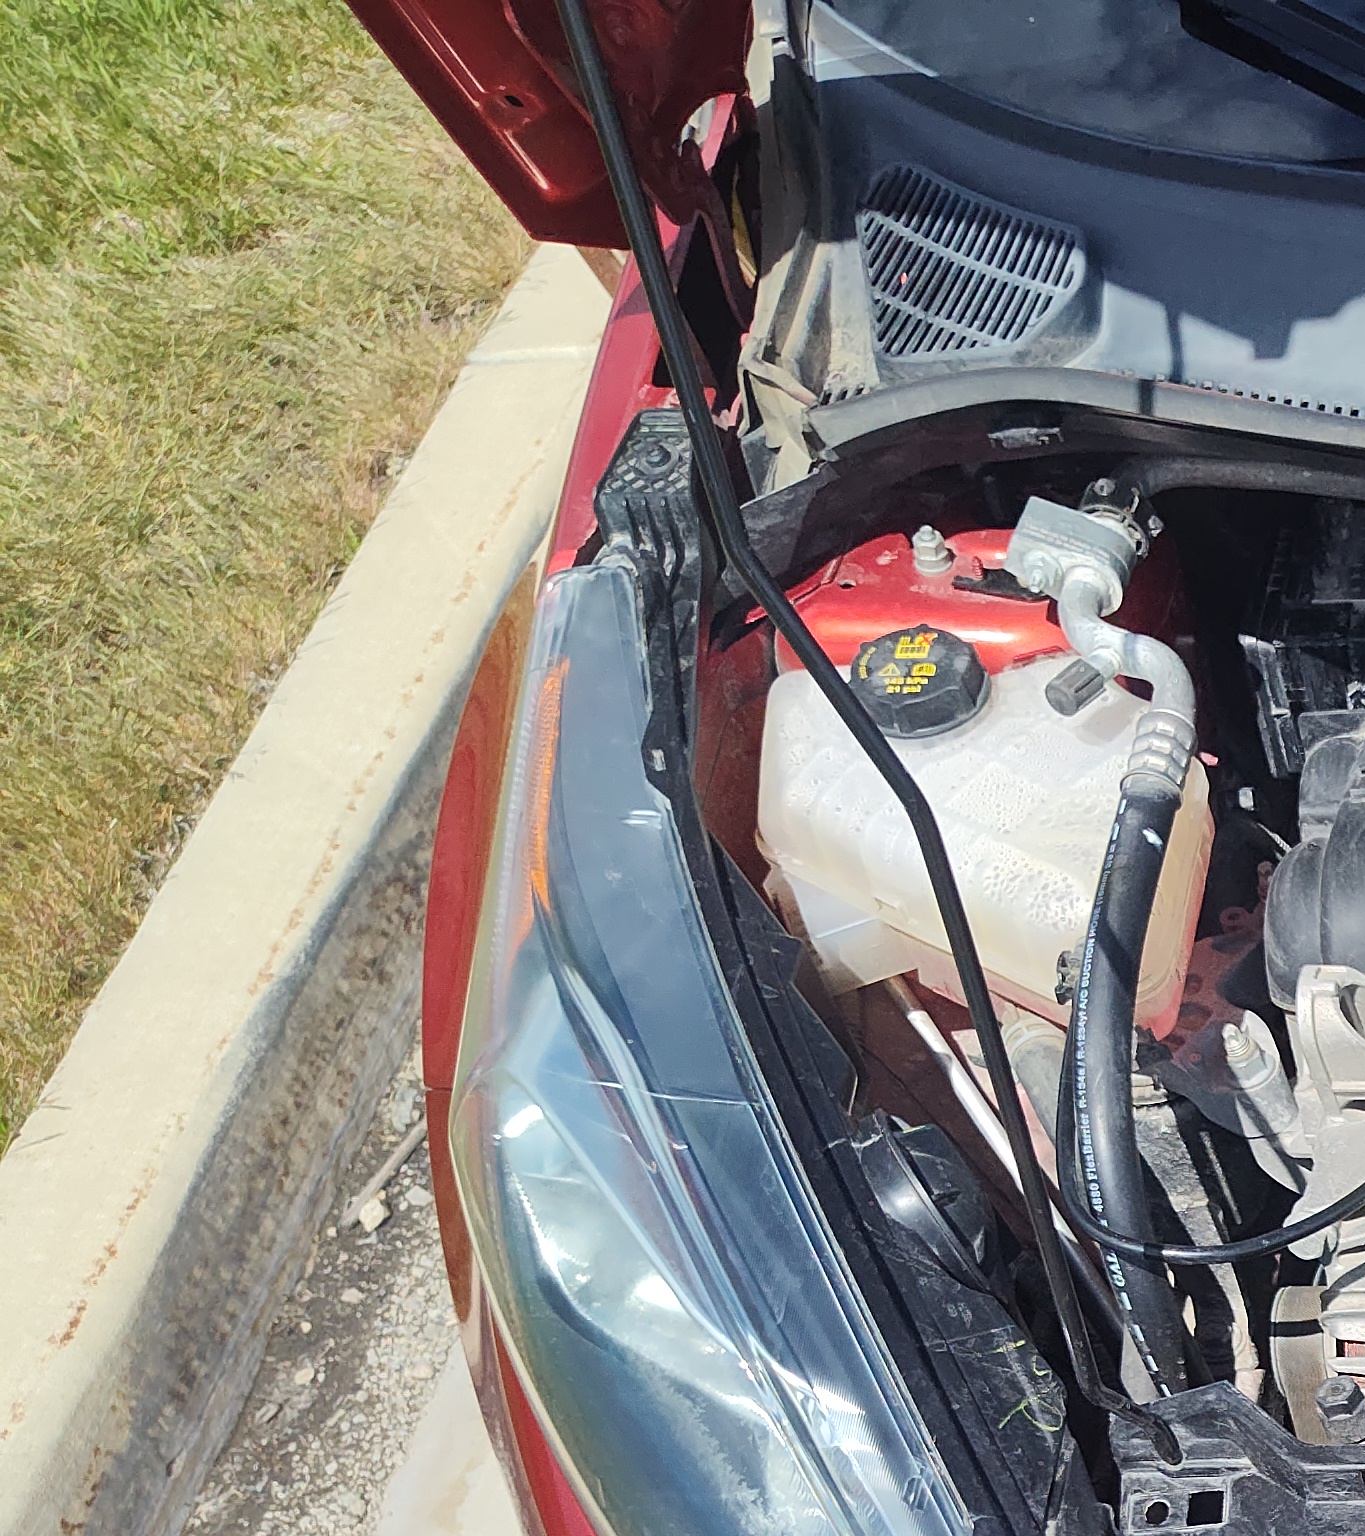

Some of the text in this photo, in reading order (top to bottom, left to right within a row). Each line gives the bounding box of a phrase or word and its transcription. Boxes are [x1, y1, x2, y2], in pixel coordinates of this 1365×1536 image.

[1088, 907, 1100, 937] HOSE
[1081, 938, 1095, 988] SUCTION
[1079, 989, 1089, 1009] A/C
[1076, 1011, 1088, 1058] R-1234yf
[1077, 1066, 1087, 1108] R-134a
[1079, 1113, 1098, 1180] FlexBarrier
[1088, 1182, 1105, 1213] 4880
